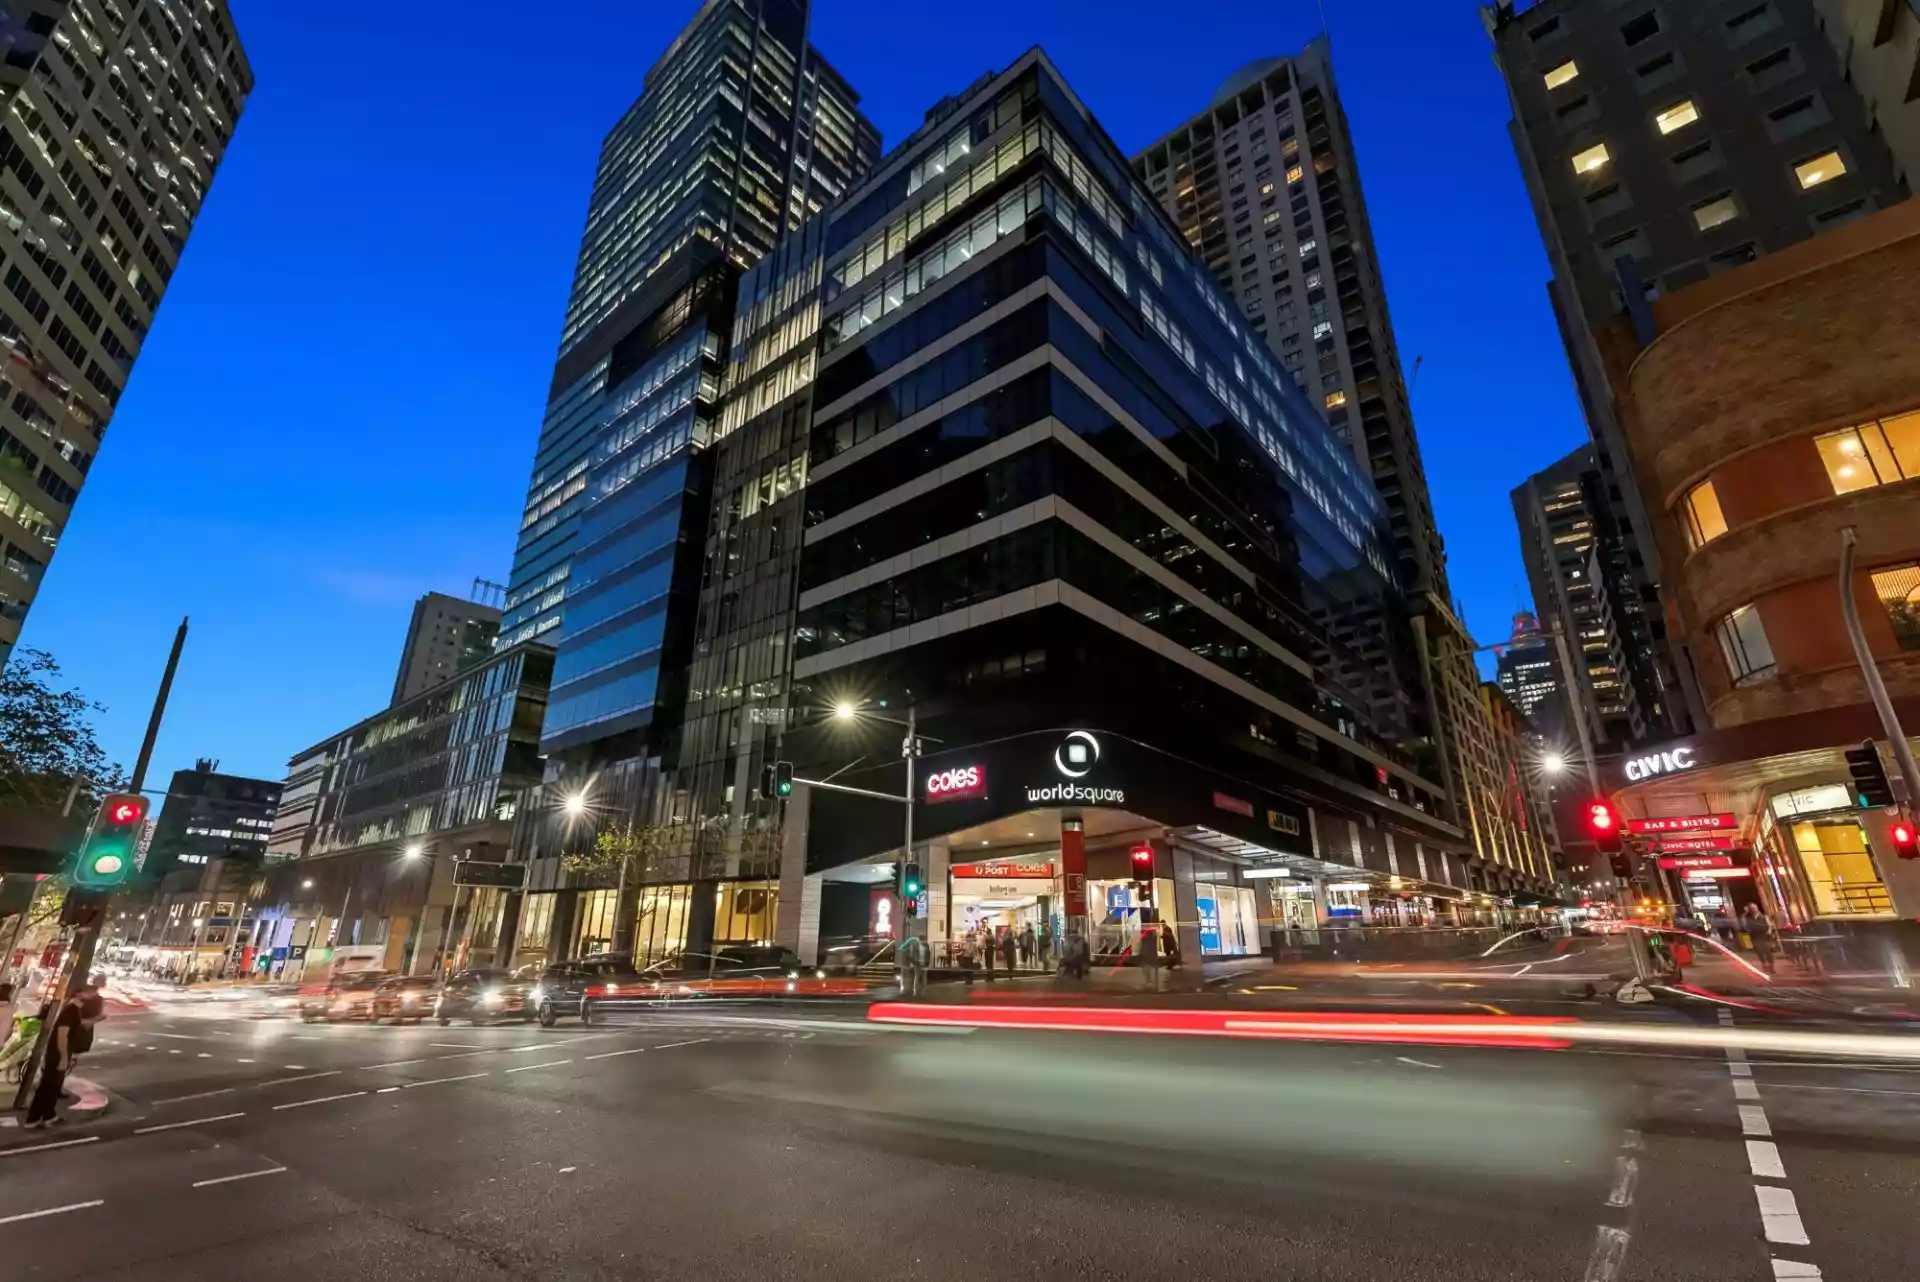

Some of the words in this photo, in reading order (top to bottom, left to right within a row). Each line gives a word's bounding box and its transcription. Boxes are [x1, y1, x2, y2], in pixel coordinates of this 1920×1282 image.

[1625, 747, 1696, 780] CIVIC
[927, 766, 978, 792] coles
[1027, 783, 1125, 803] worldsquare
[1644, 821, 1665, 829] BAR
[1681, 818, 1719, 827] BISTRO
[985, 867, 1008, 875] POST
